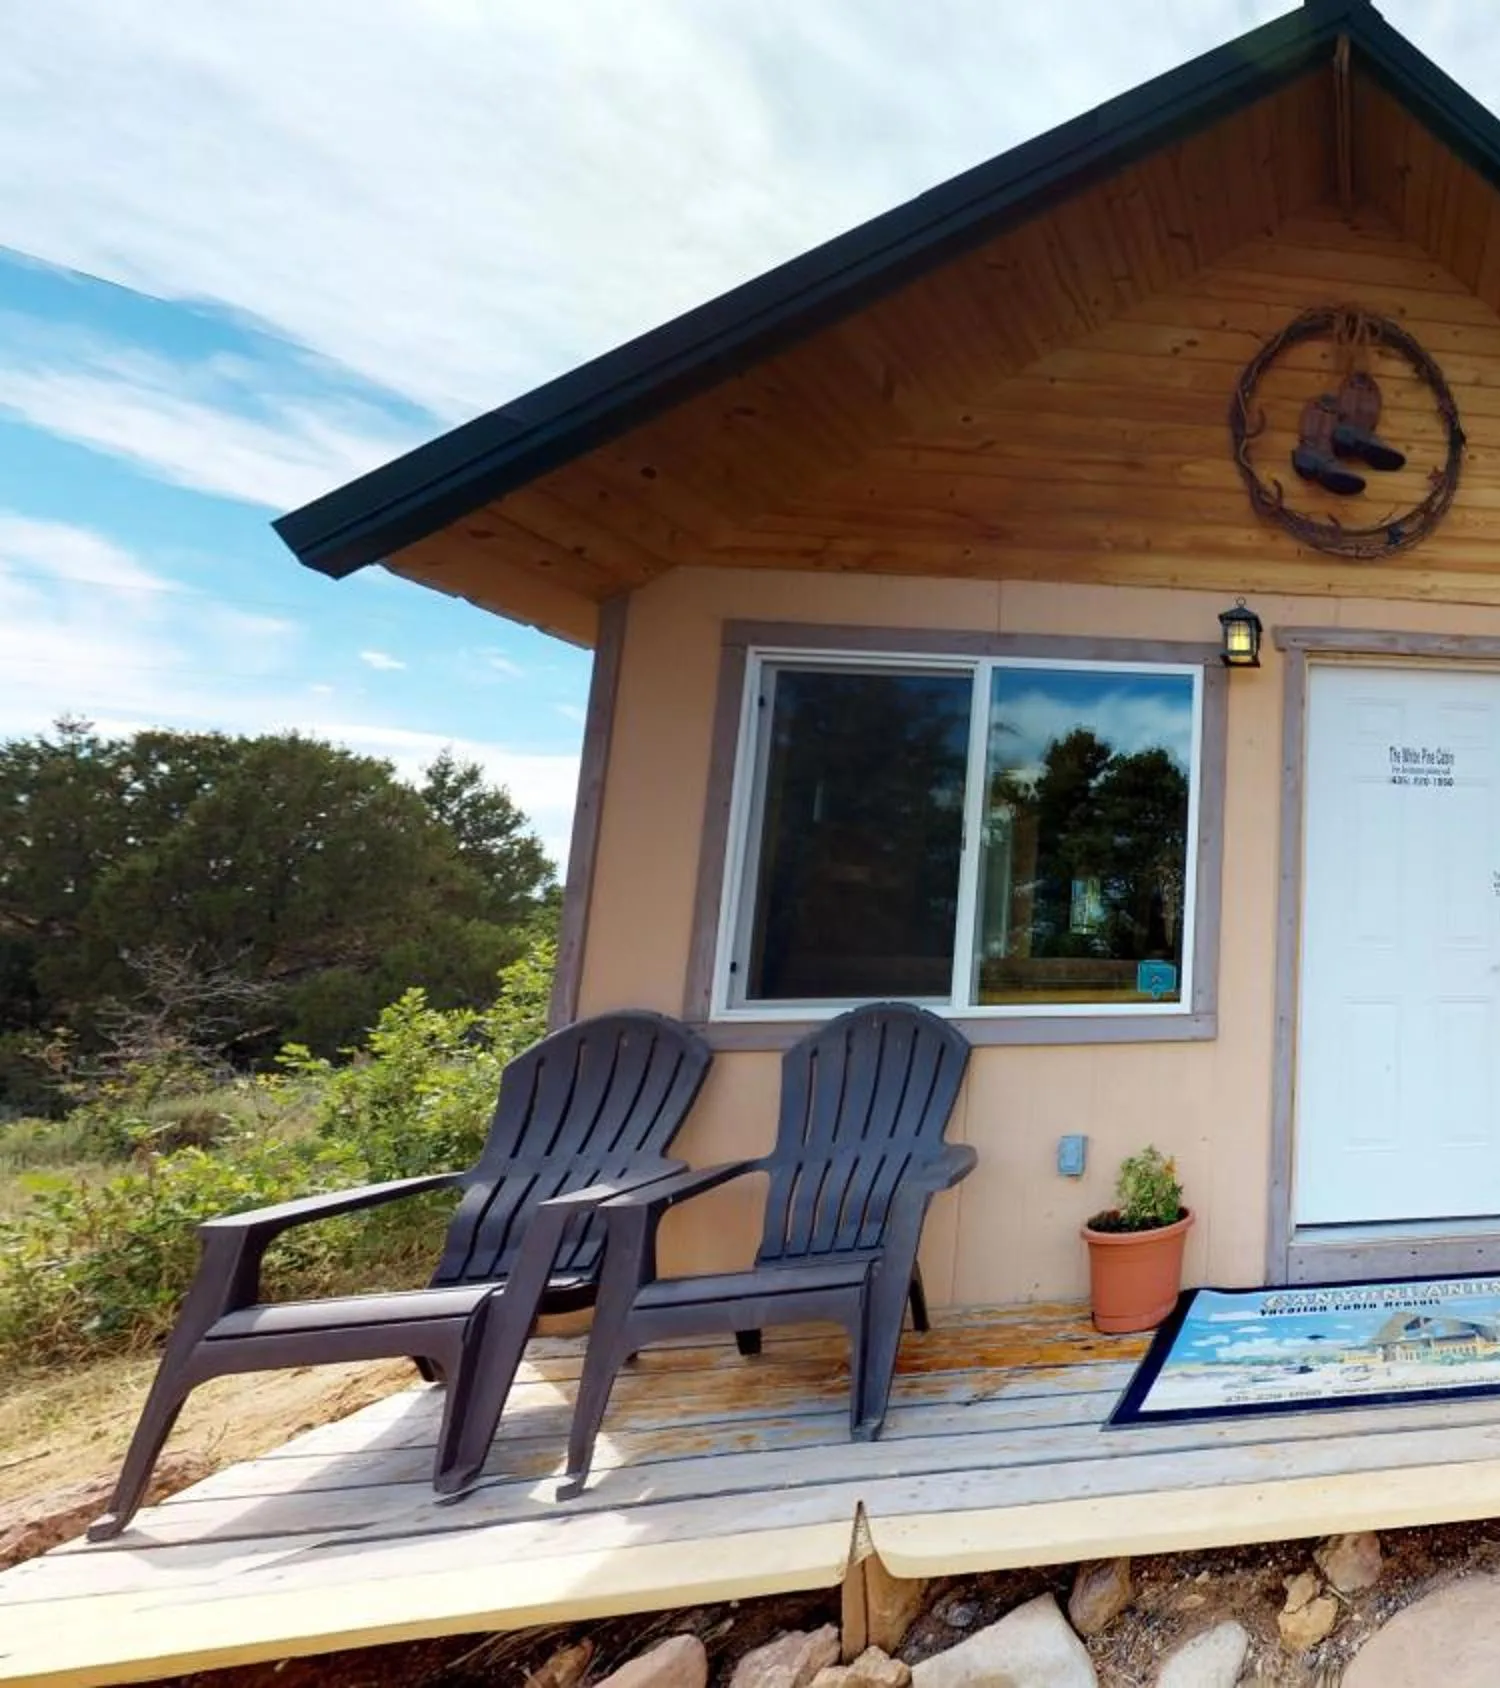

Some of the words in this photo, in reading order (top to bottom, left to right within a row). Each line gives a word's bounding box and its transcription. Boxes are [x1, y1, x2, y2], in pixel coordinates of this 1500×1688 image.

[1260, 1304, 1328, 1317] Vacation
[1334, 1301, 1378, 1312] Cabin
[1383, 1298, 1441, 1308] Rentals
